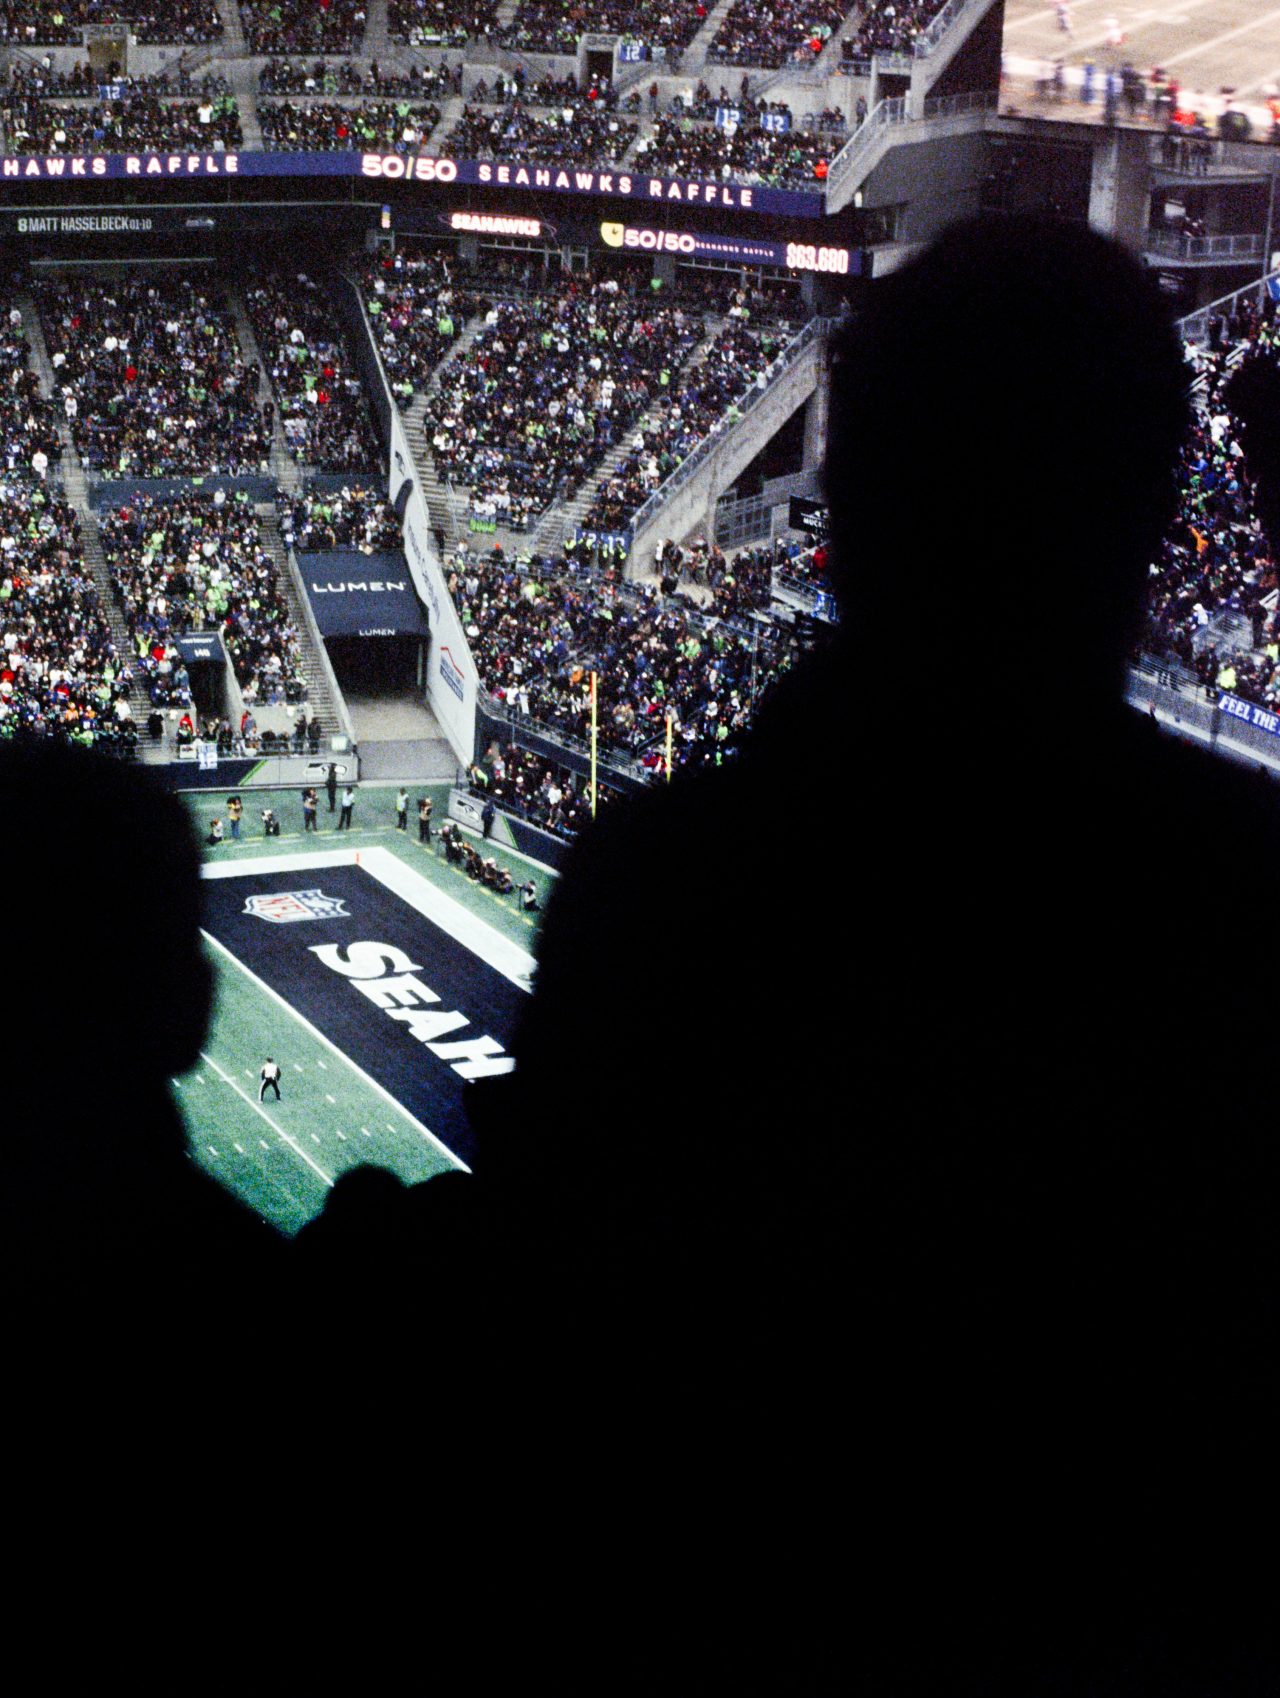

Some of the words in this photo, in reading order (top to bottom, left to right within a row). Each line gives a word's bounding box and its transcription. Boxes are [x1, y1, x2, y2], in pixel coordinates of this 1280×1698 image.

[126, 155, 239, 174] RAFFLE
[362, 154, 458, 182] 50/50
[478, 165, 632, 194] SEAHAWKS
[649, 179, 754, 206] RAFFLE
[28, 216, 58, 232] MATT
[60, 216, 128, 232] HASSELBECK
[451, 212, 541, 237] SEAHAWKS
[624, 230, 696, 252] 50/50
[312, 582, 405, 592] LUMEN
[359, 628, 396, 636] LUMEN
[1219, 694, 1250, 721] FEEL
[1252, 707, 1279, 731] THE
